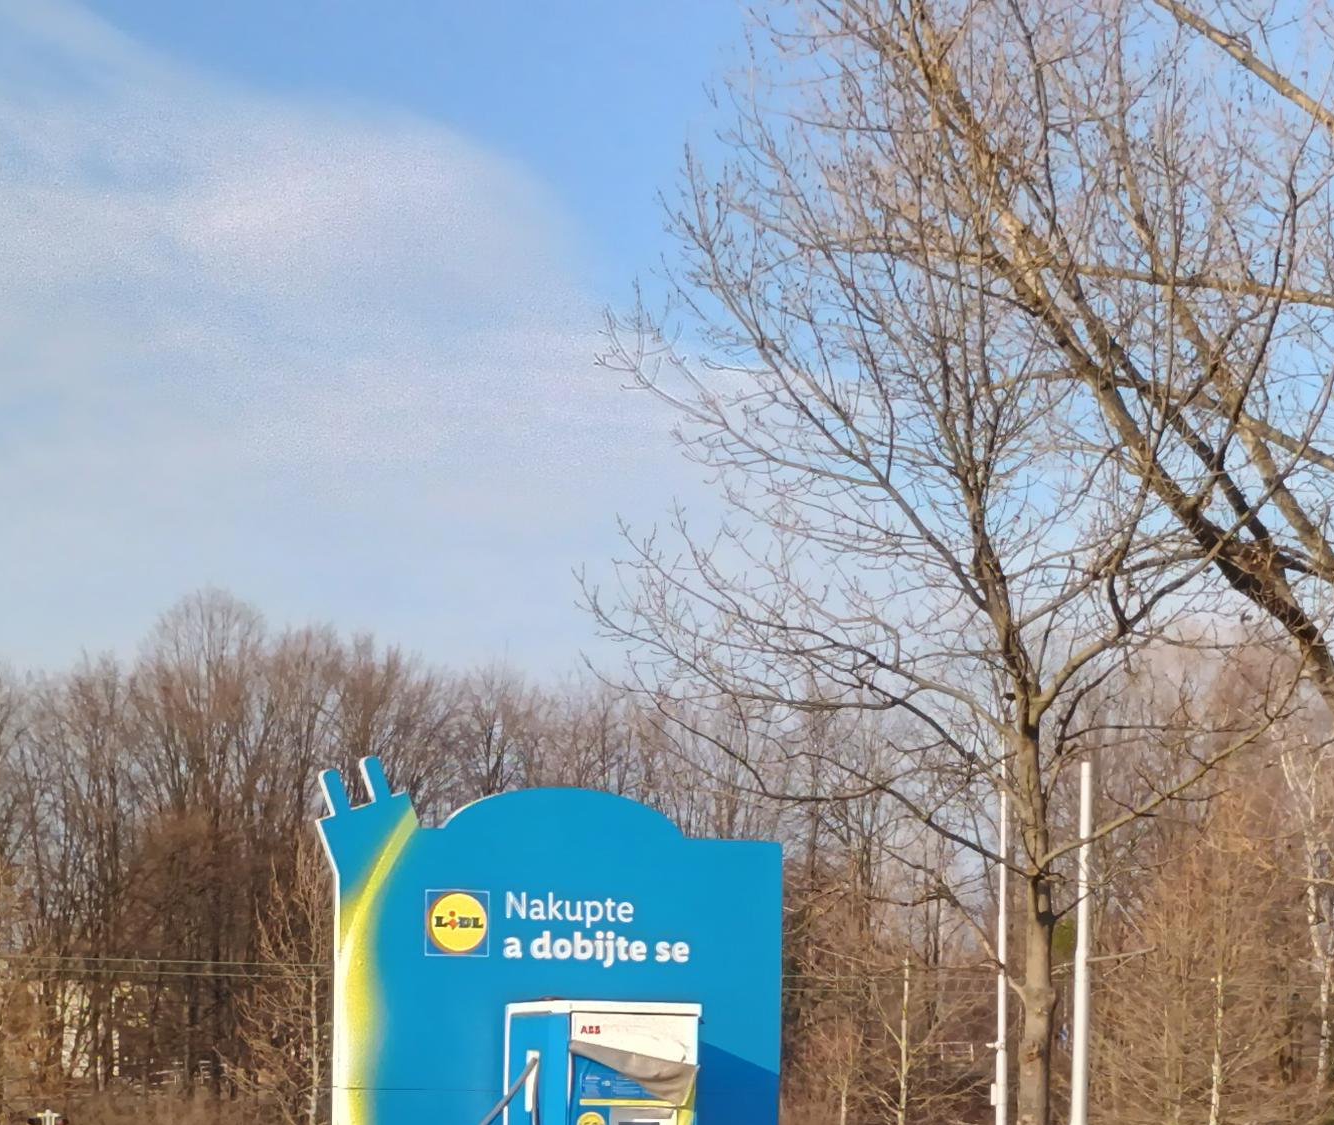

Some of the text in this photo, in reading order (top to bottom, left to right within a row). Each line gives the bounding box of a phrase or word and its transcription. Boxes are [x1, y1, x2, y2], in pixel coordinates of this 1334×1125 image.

[505, 891, 635, 929] Nakupte
[503, 930, 690, 968] a dobijte se
